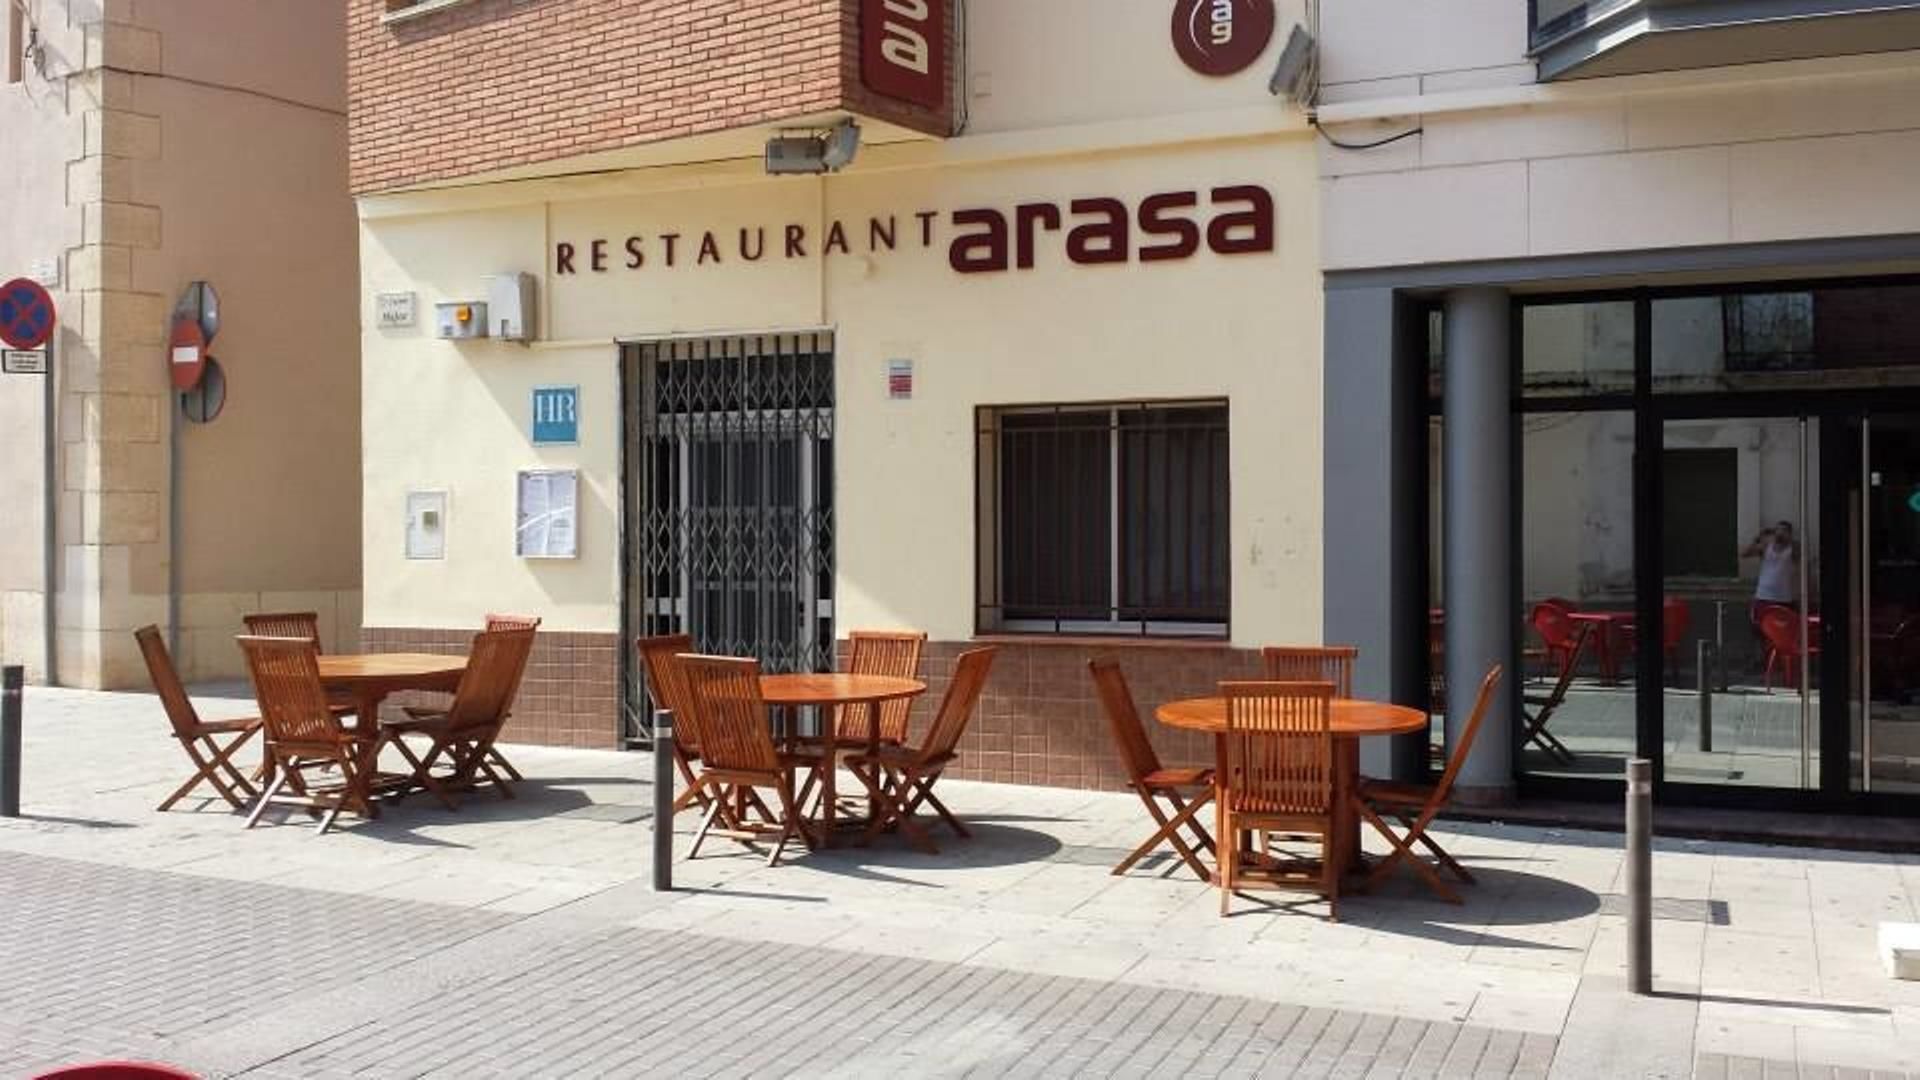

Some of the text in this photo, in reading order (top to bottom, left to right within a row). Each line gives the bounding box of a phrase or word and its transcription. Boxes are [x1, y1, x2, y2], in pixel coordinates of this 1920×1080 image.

[556, 184, 1275, 275] RESTAURANT arasa
[536, 393, 575, 423] HR
